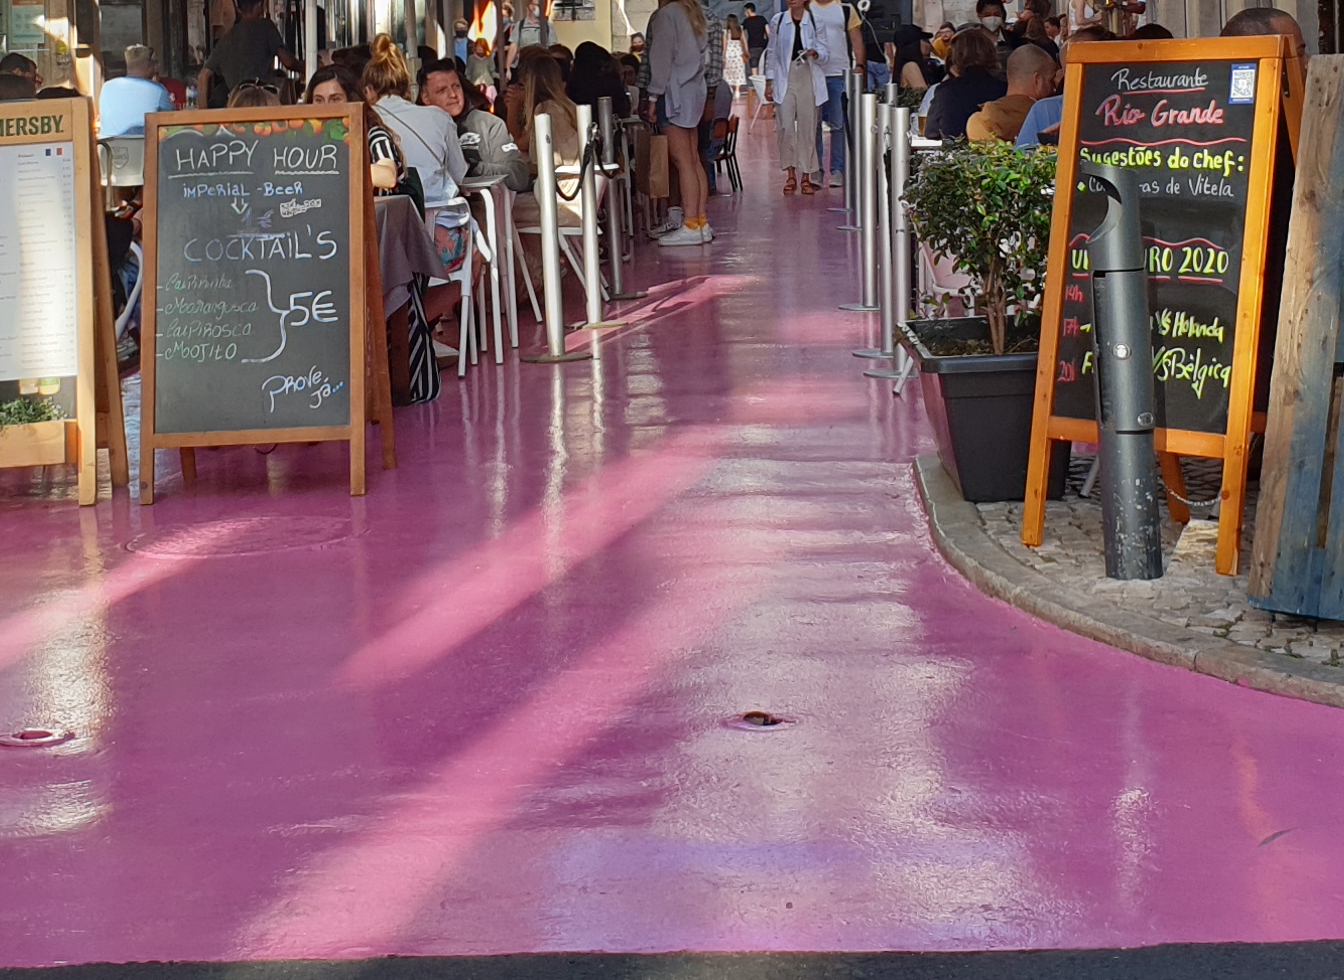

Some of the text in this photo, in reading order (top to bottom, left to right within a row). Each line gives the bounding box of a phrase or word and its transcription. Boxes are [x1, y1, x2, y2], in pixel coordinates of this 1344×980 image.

[1111, 67, 1209, 91] Restaurante
[1095, 94, 1225, 127] Rio Grande
[175, 139, 338, 171] HAPPY HOUR
[1079, 146, 1162, 169] Sugestões
[1167, 146, 1189, 169] do
[1165, 176, 1181, 194] de
[1188, 173, 1234, 197] Vitela
[1178, 247, 1229, 274] 2020
[1065, 284, 1083, 303] 14h
[289, 290, 339, 327] 5€
[1172, 311, 1224, 344] Holanda
